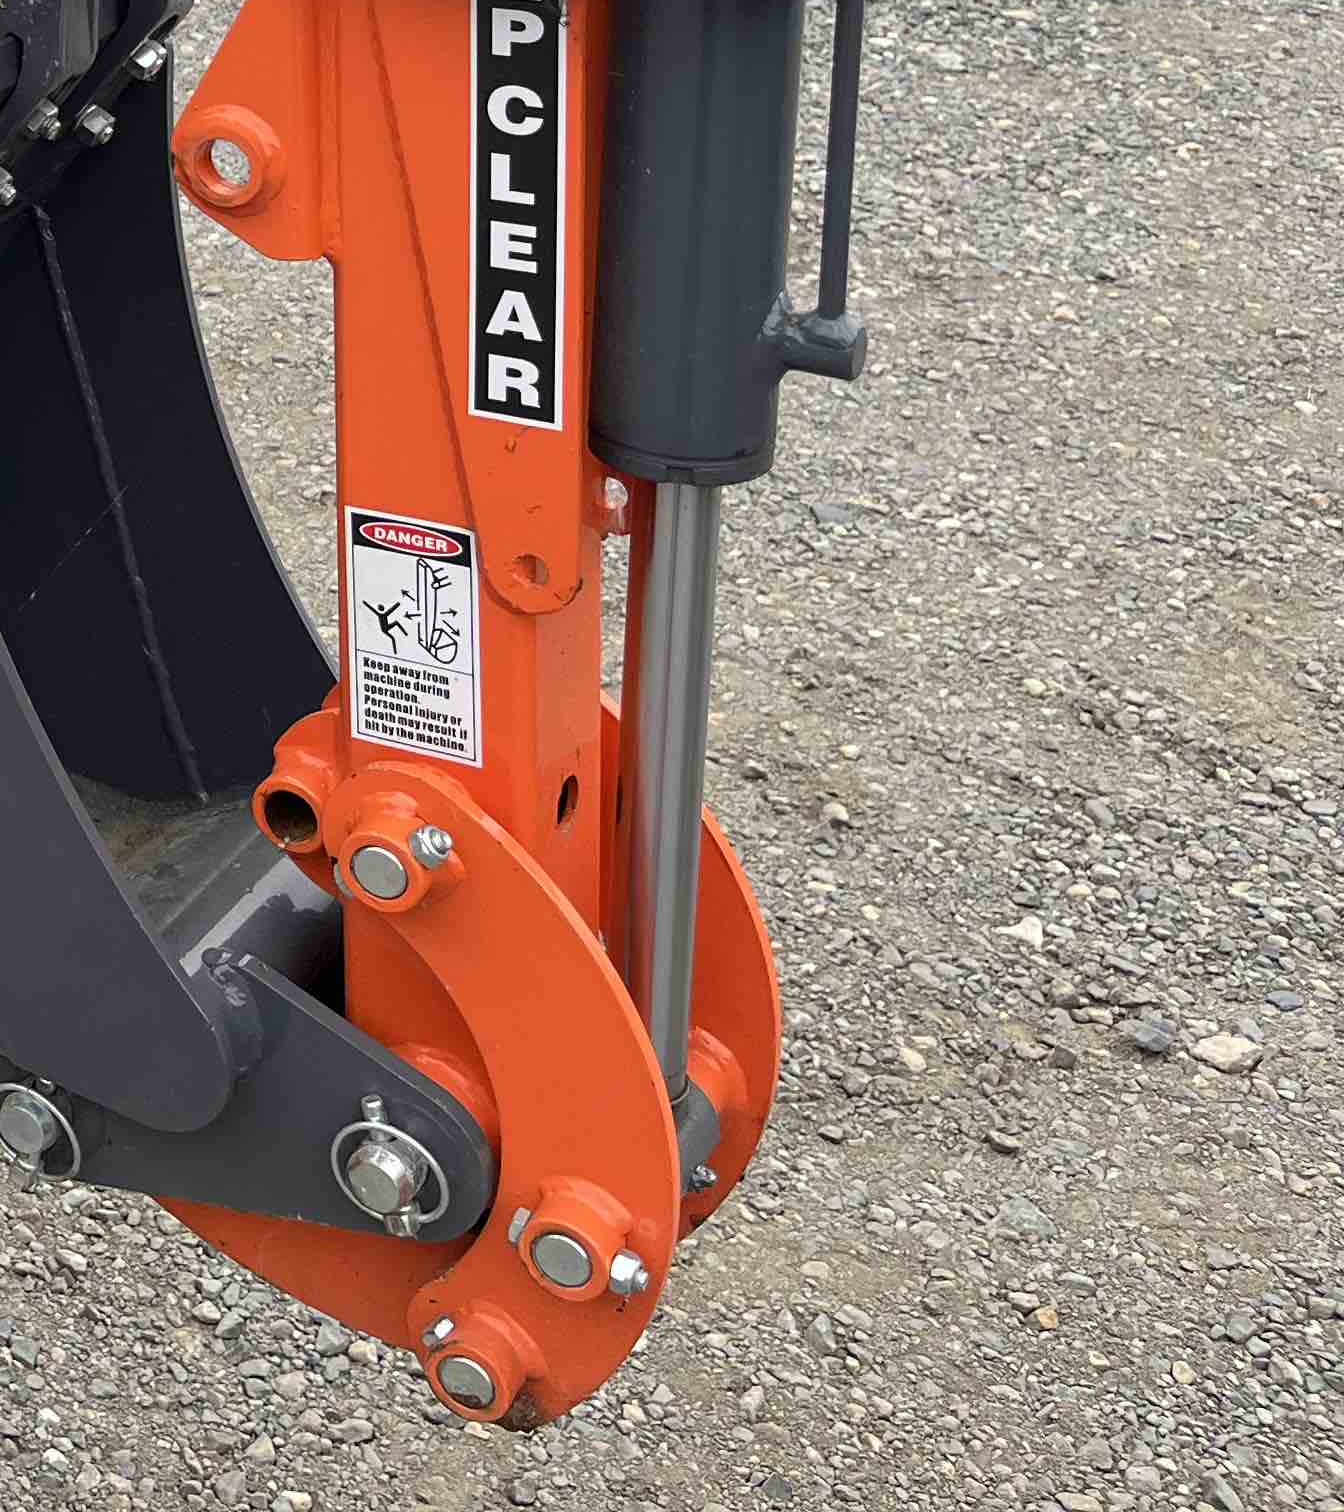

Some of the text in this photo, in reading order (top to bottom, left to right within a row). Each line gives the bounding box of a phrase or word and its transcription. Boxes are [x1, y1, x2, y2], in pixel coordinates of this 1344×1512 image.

[485, 85, 544, 409] CLEAR
[374, 526, 448, 554] DANGER
[363, 656, 449, 686] Keep away from
[363, 671, 450, 700] machine during
[364, 683, 421, 705] operation.
[364, 694, 413, 716] Personal
[450, 715, 462, 727] or
[364, 707, 468, 741] death may result if
[364, 719, 469, 754] hit by the machine.
